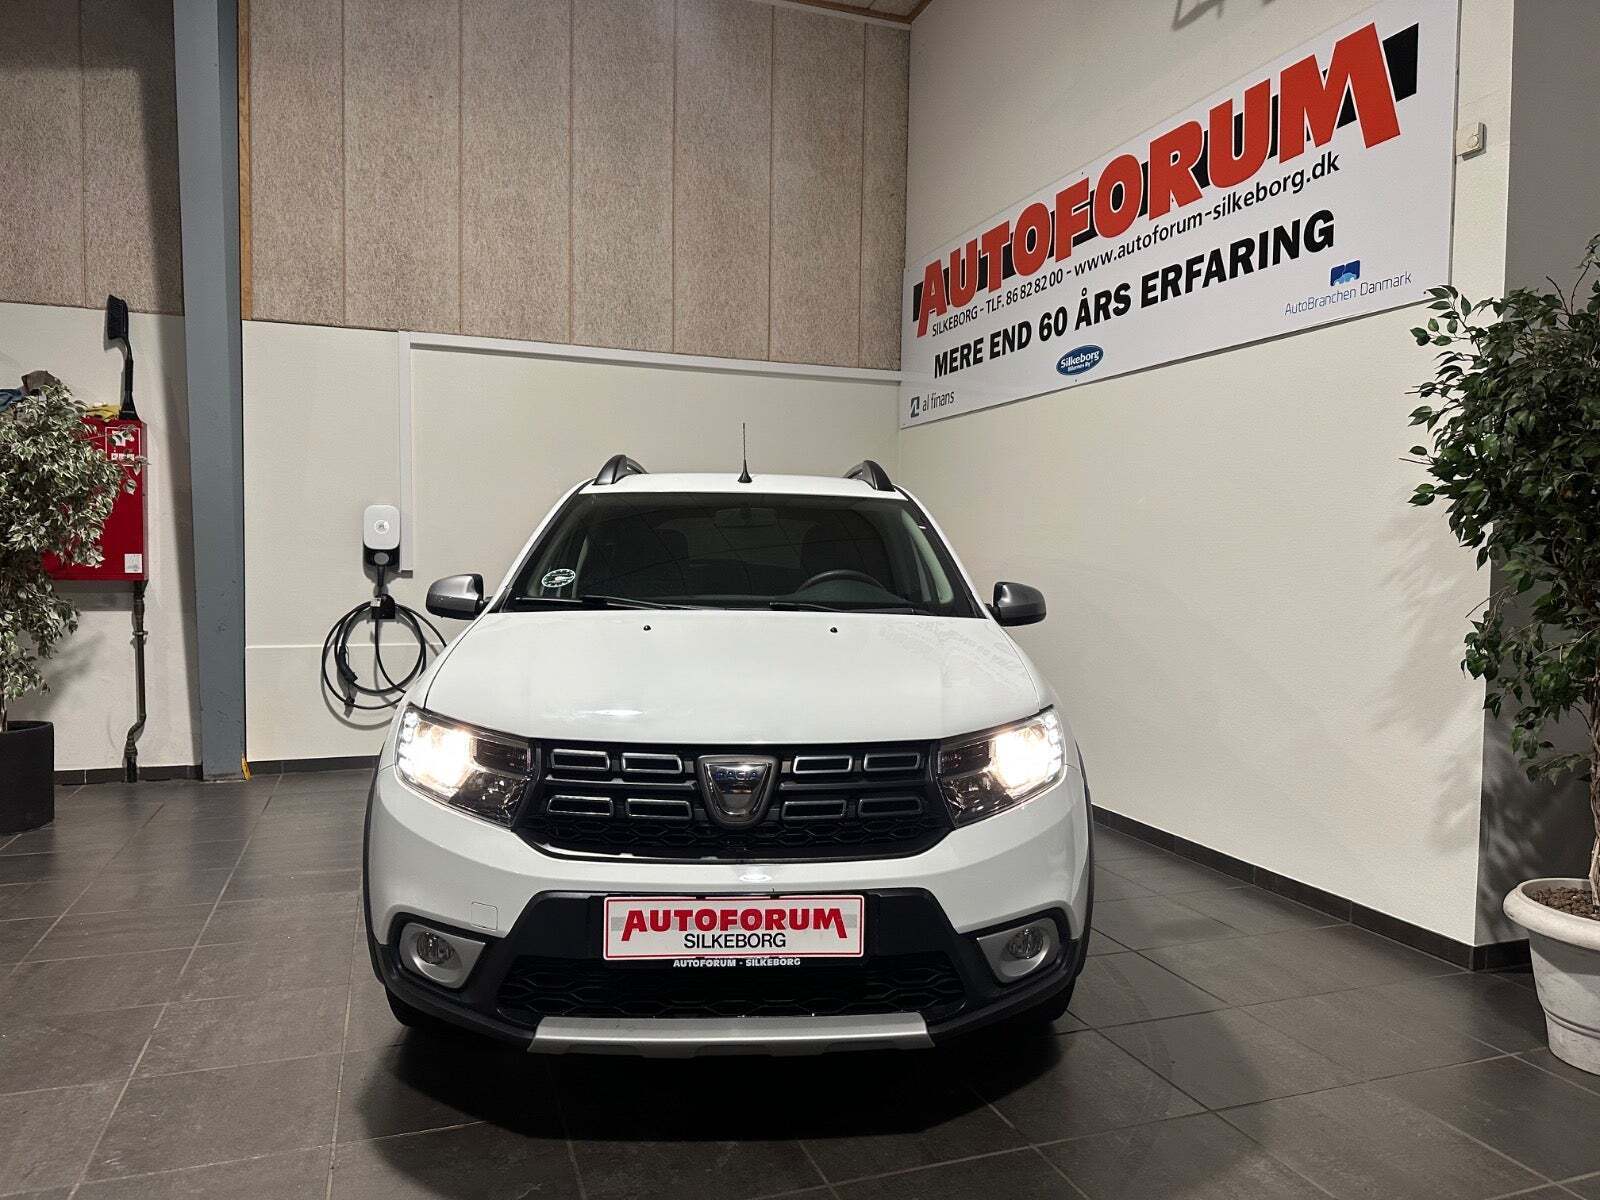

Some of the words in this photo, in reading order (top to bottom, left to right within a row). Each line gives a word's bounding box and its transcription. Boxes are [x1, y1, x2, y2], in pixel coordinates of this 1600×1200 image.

[917, 22, 1401, 338] AUTOFORUM
[932, 306, 978, 337] SILKEBORG
[986, 295, 1005, 315] TLF.
[1006, 287, 1019, 305] 86
[1020, 282, 1033, 300] 82
[1034, 276, 1048, 294] 82
[1049, 268, 1063, 287] 00
[1074, 151, 1341, 278] www.autoforum-silkeborg.dk
[934, 336, 984, 380] MERE
[989, 320, 1032, 361] END
[1038, 306, 1068, 342] 60
[1074, 287, 1132, 332] ÅRS
[1140, 209, 1335, 309] ERFARING
[1284, 287, 1357, 316] AutoBranchen
[1359, 271, 1412, 297] Danmark
[1060, 350, 1100, 369] Silkeborg
[922, 397, 930, 413] al
[931, 391, 955, 409] finans
[621, 908, 848, 942] AUTOFORUM
[683, 932, 786, 949] SILKEBORG
[673, 959, 737, 968] AUTOFORUM
[745, 957, 801, 967] SILKEBORG
